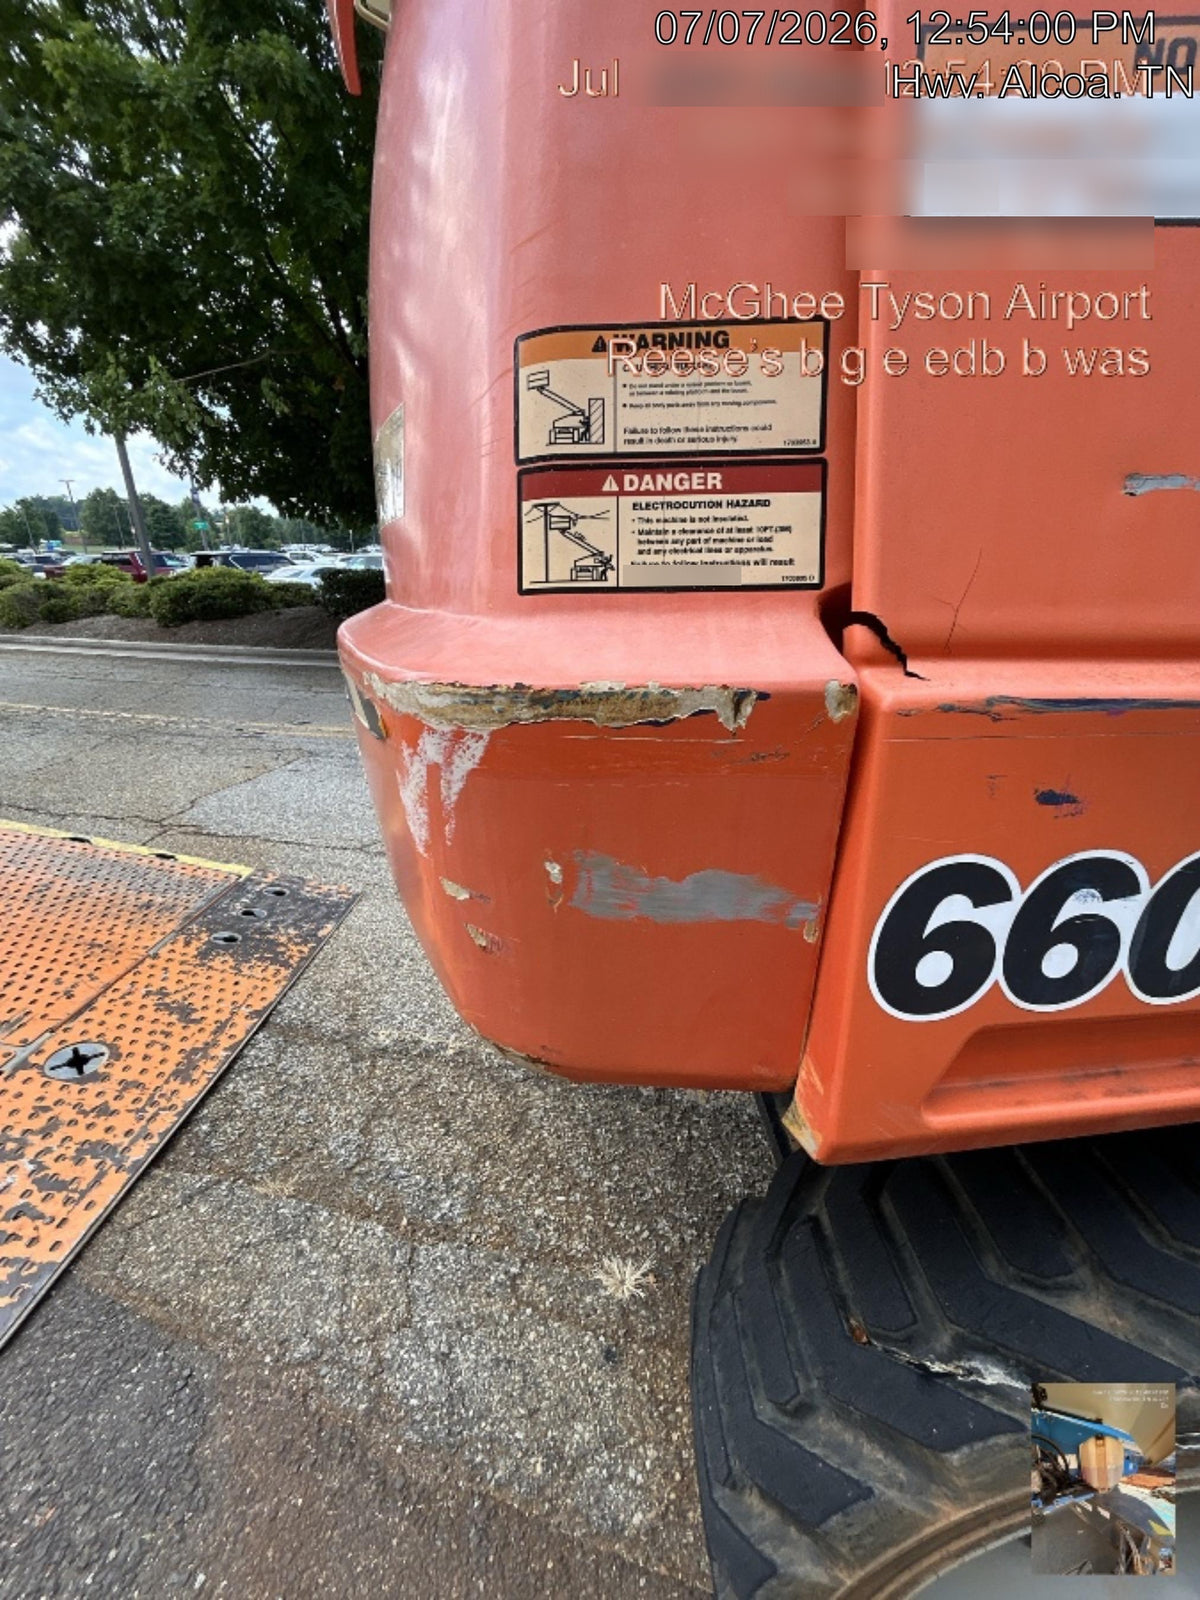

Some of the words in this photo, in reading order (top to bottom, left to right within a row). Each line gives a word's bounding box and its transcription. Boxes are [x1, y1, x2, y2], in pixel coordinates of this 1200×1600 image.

[623, 473, 723, 492] DANGER
[632, 500, 723, 511] ELECTROCUTION
[726, 499, 771, 509] HAZARD
[869, 850, 1200, 1021] 660
